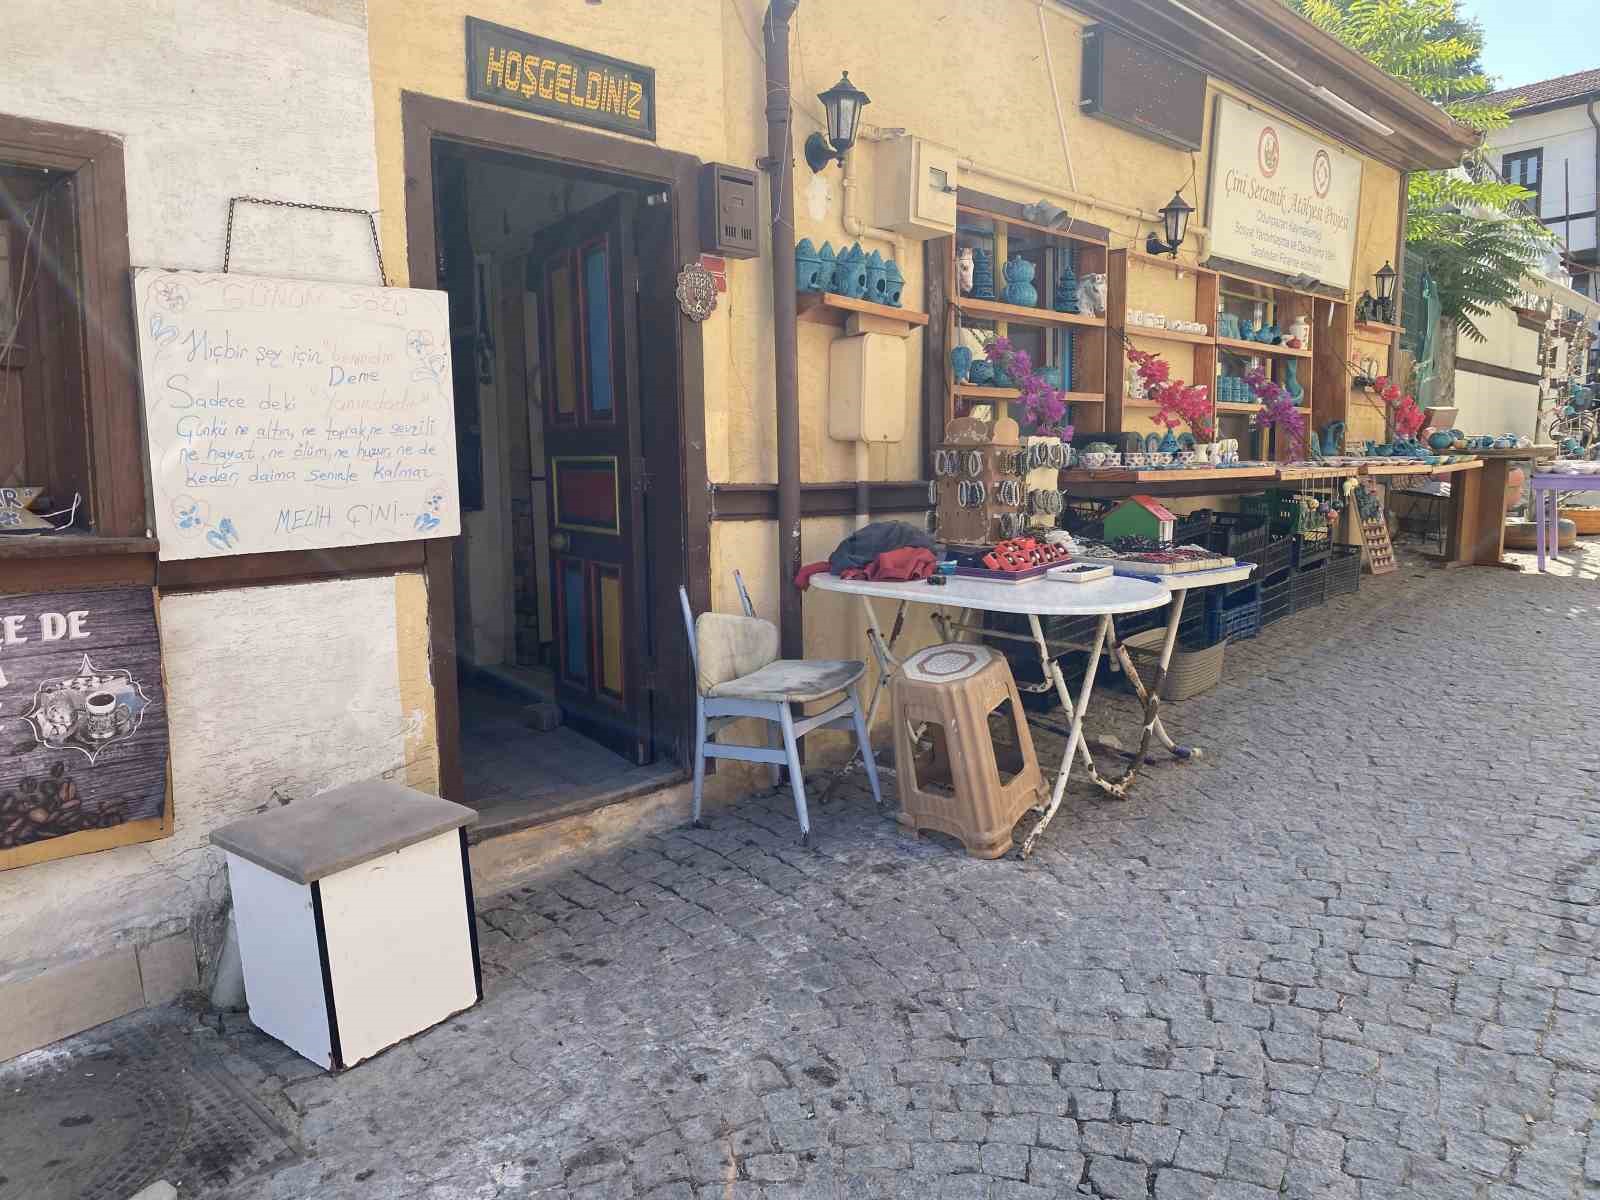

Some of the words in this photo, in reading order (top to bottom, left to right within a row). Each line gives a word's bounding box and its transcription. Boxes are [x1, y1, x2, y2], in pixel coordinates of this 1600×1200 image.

[486, 47, 643, 120] HOŞGELDİNİZ
[1225, 168, 1248, 199] Çini
[166, 373, 246, 409] Sadece
[328, 366, 380, 387] Deme
[39, 610, 91, 641] DE
